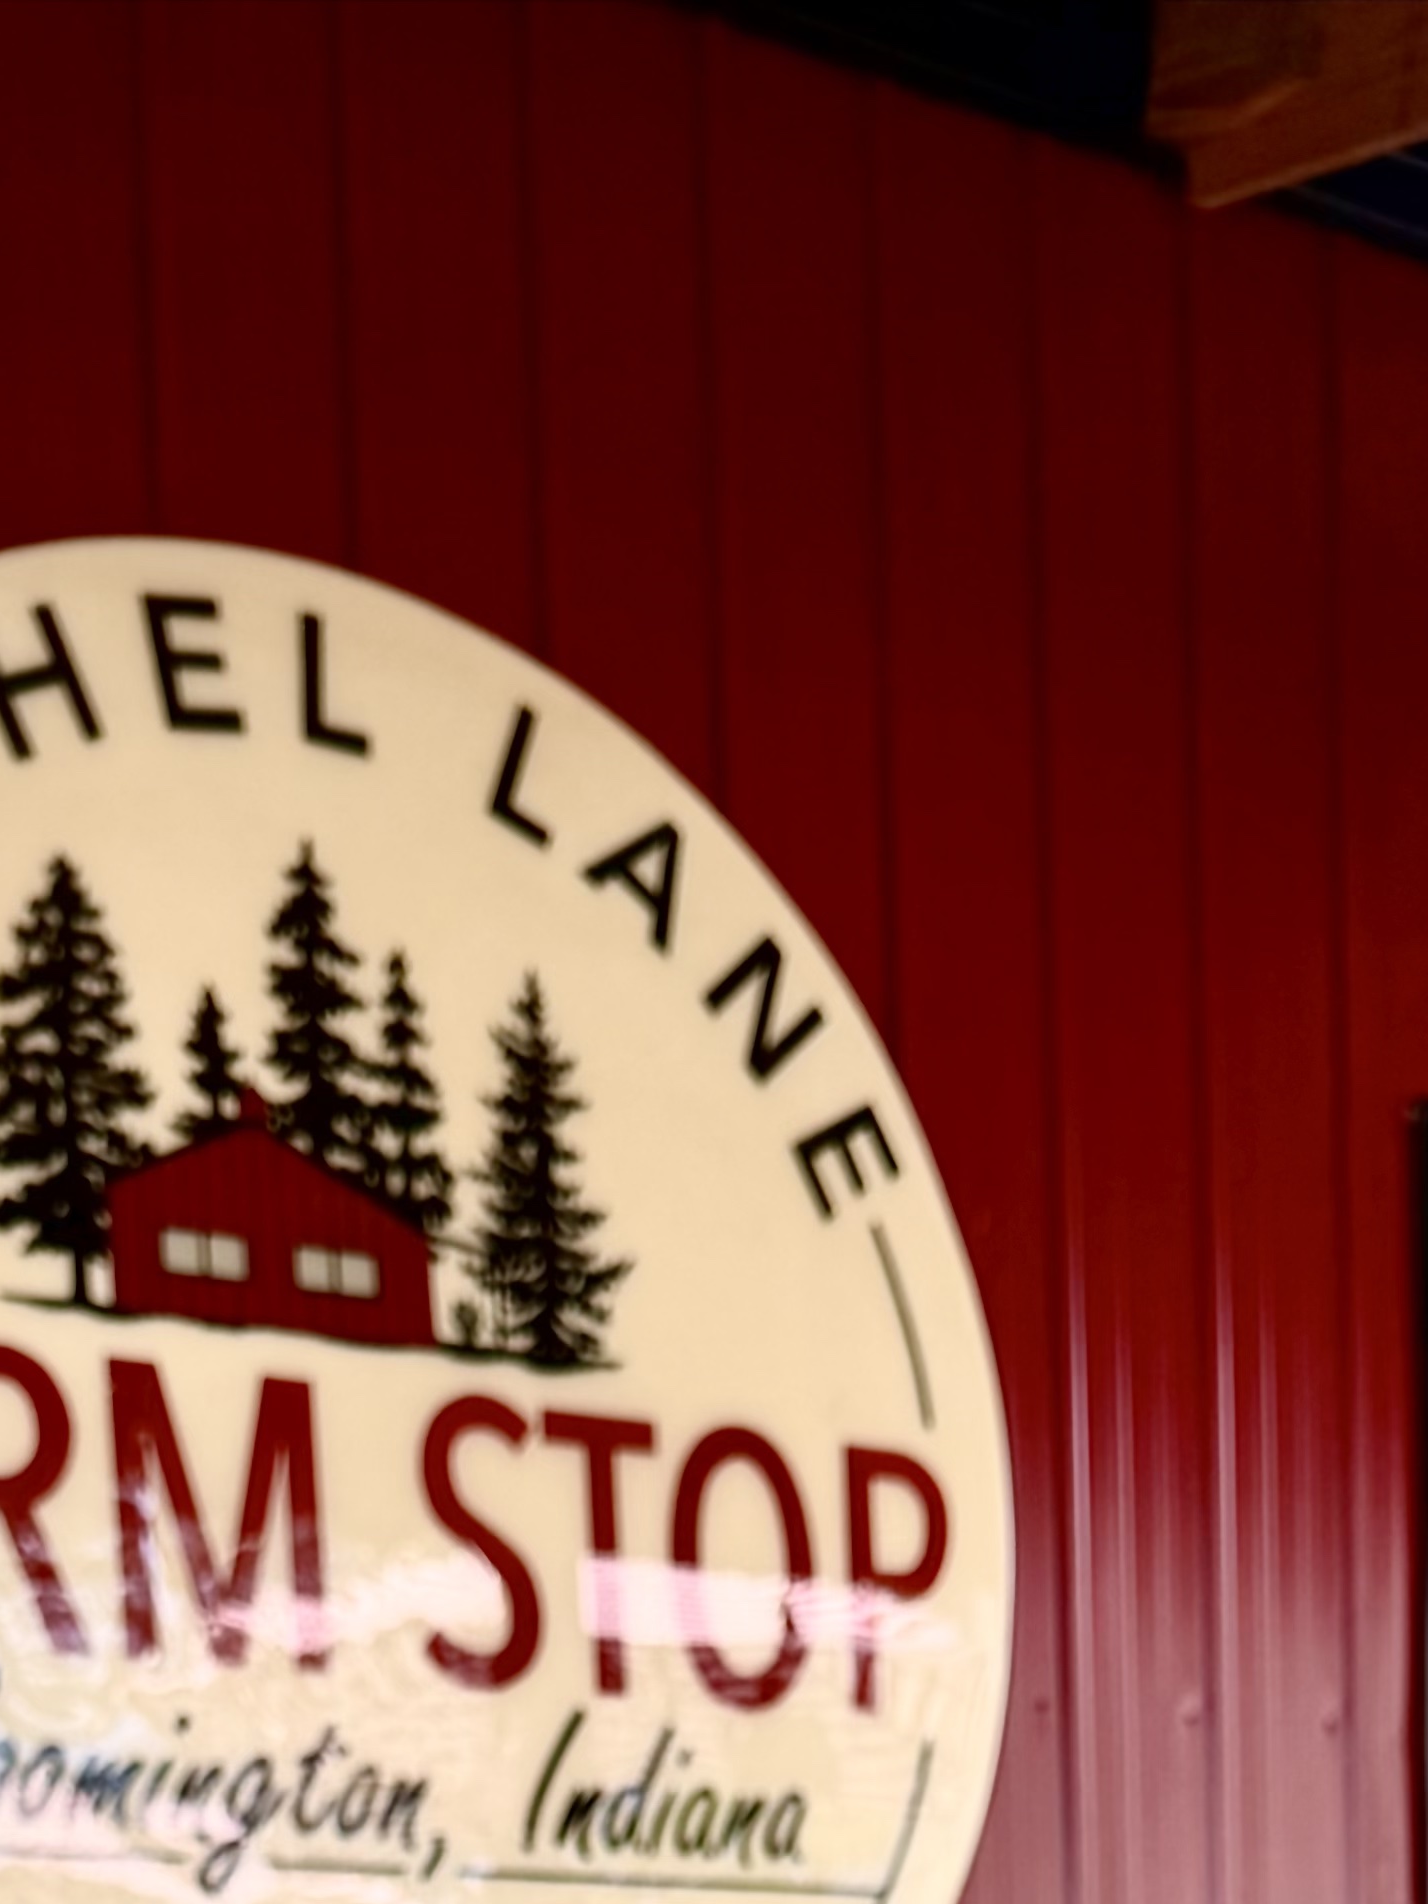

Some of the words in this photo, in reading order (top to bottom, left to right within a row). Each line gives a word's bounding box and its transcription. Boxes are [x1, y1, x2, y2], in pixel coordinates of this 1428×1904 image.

[487, 706, 900, 1223] LANE
[418, 1394, 950, 1712] STOP
[521, 1709, 804, 1867] Indiana
